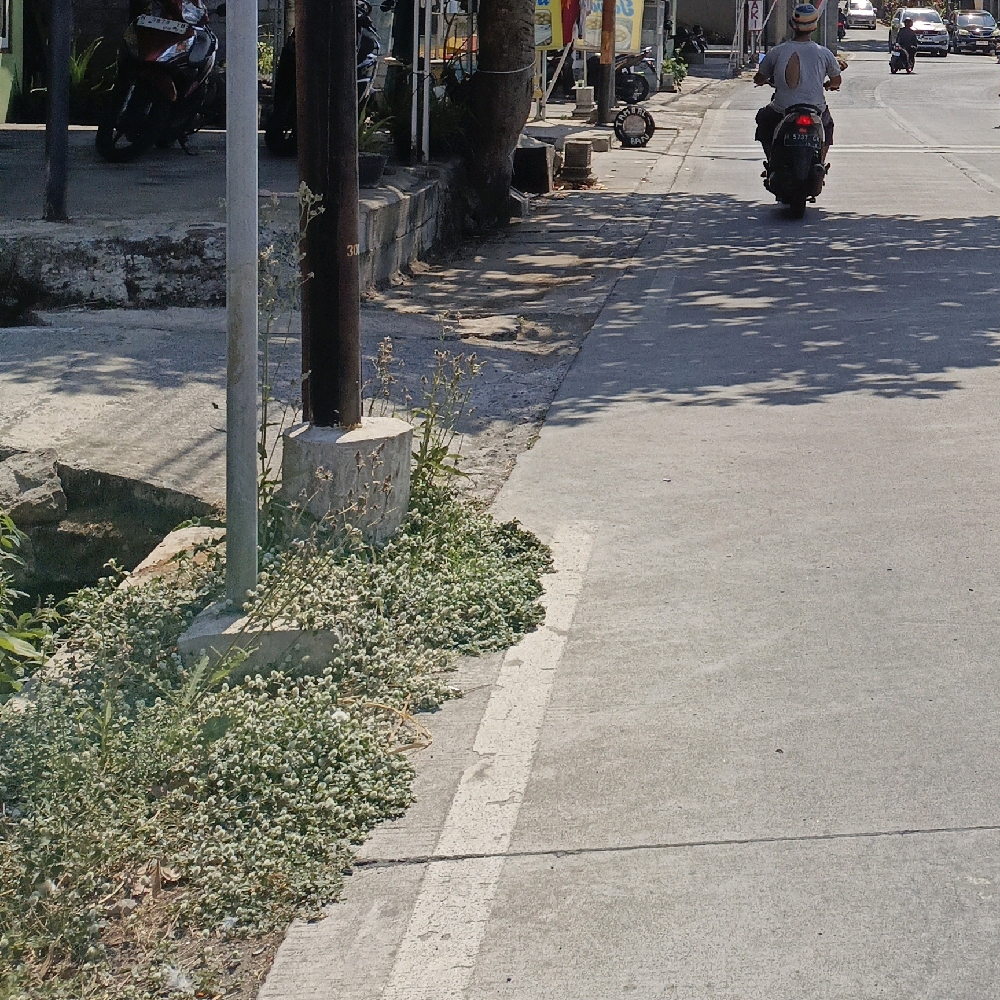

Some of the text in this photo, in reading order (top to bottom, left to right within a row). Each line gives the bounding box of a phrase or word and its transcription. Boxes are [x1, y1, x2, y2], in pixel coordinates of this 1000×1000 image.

[750, 1, 759, 29] AKI
[615, 107, 647, 128] TAMBAL
[631, 133, 650, 145] BAN
